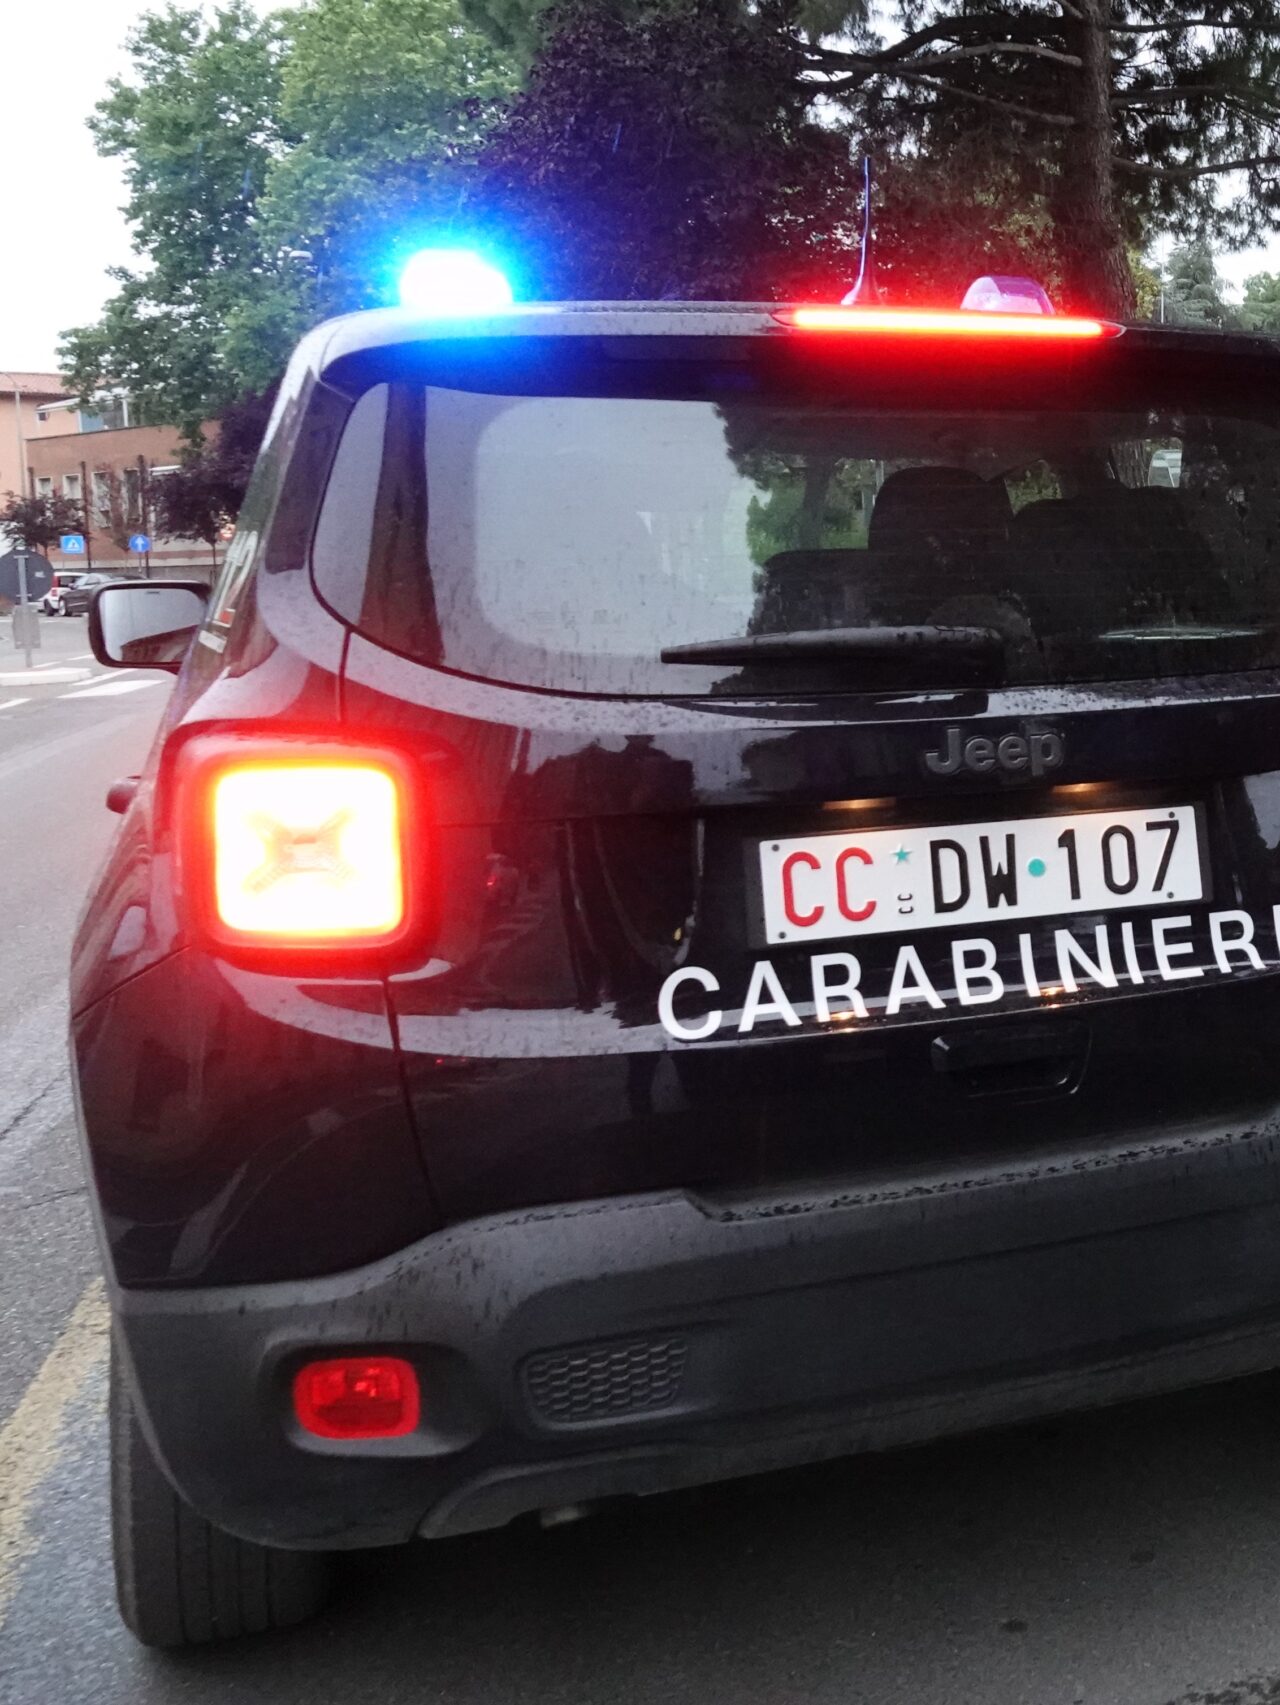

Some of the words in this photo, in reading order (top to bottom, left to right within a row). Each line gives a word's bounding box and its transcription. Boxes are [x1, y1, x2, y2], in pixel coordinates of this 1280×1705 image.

[926, 726, 1066, 777] Jeep
[780, 846, 879, 927] CC
[928, 833, 1019, 914] DW
[1057, 818, 1181, 901] 107
